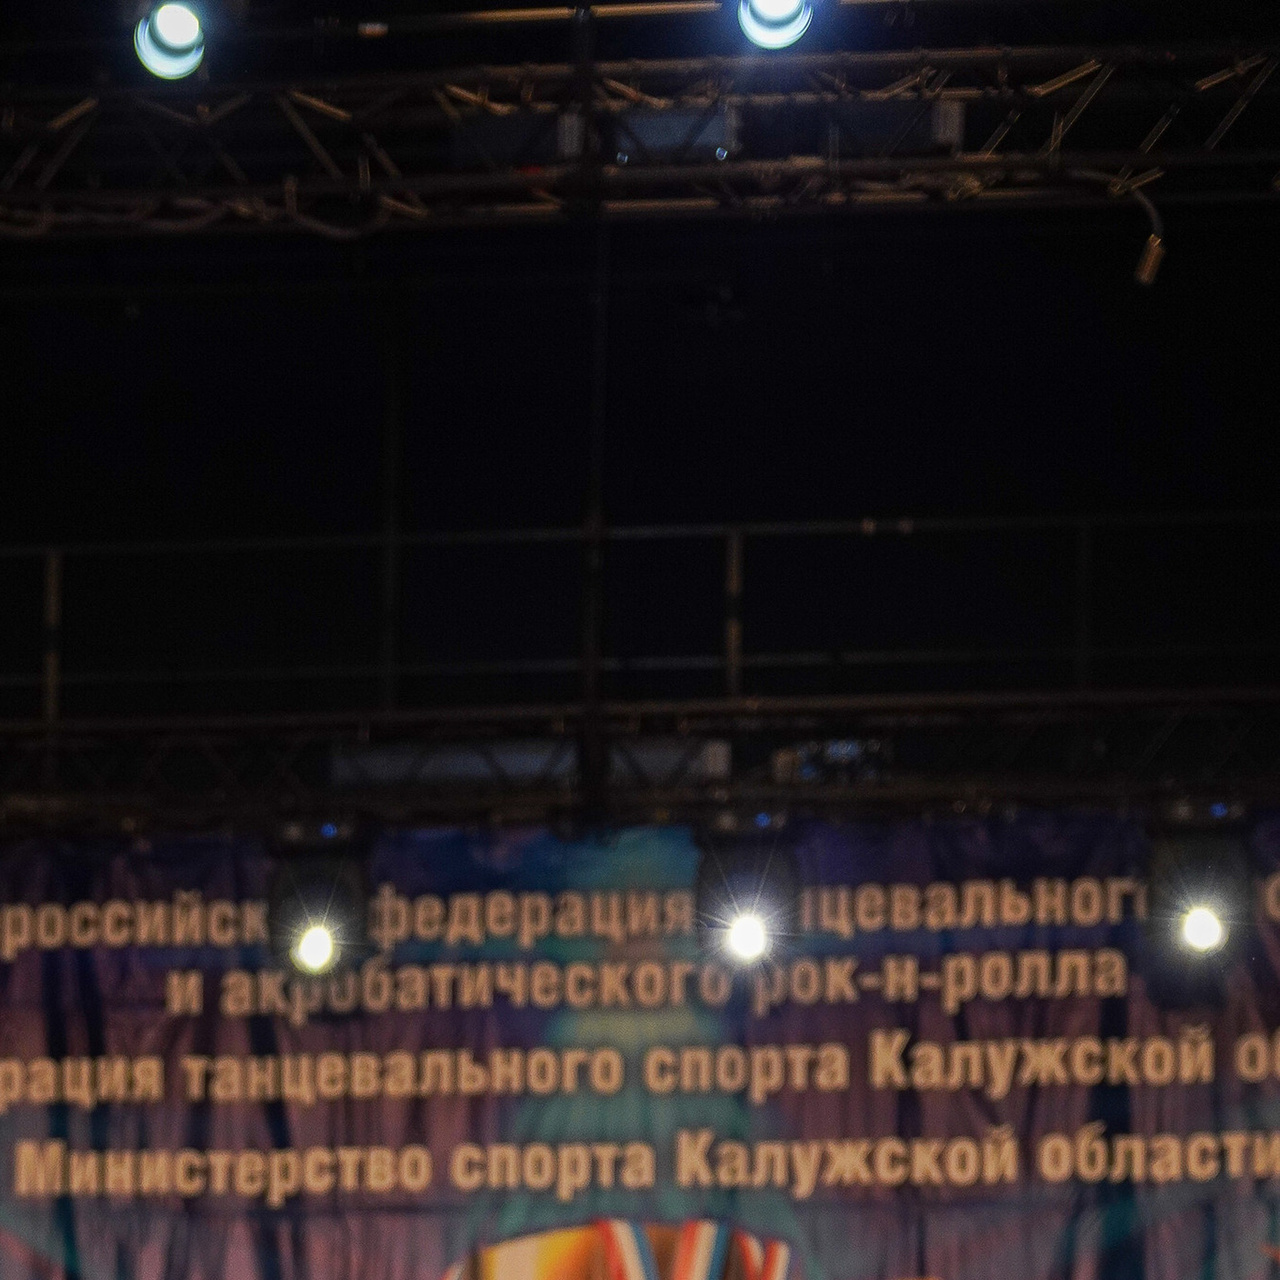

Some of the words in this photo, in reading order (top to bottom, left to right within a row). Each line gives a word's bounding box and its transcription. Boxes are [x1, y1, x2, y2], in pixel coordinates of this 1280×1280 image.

[803, 877, 1146, 935] цевальног
[165, 968, 203, 1017] и
[754, 947, 1126, 1014] рок-н-ролла
[181, 1047, 623, 1106] танцевального
[644, 1041, 850, 1105] спорта
[869, 1025, 1216, 1100] Калужской
[14, 1138, 431, 1207] Министерство
[450, 1137, 655, 1200] спорта
[675, 1124, 1018, 1199] Калужской
[1037, 1120, 1280, 1184] области
